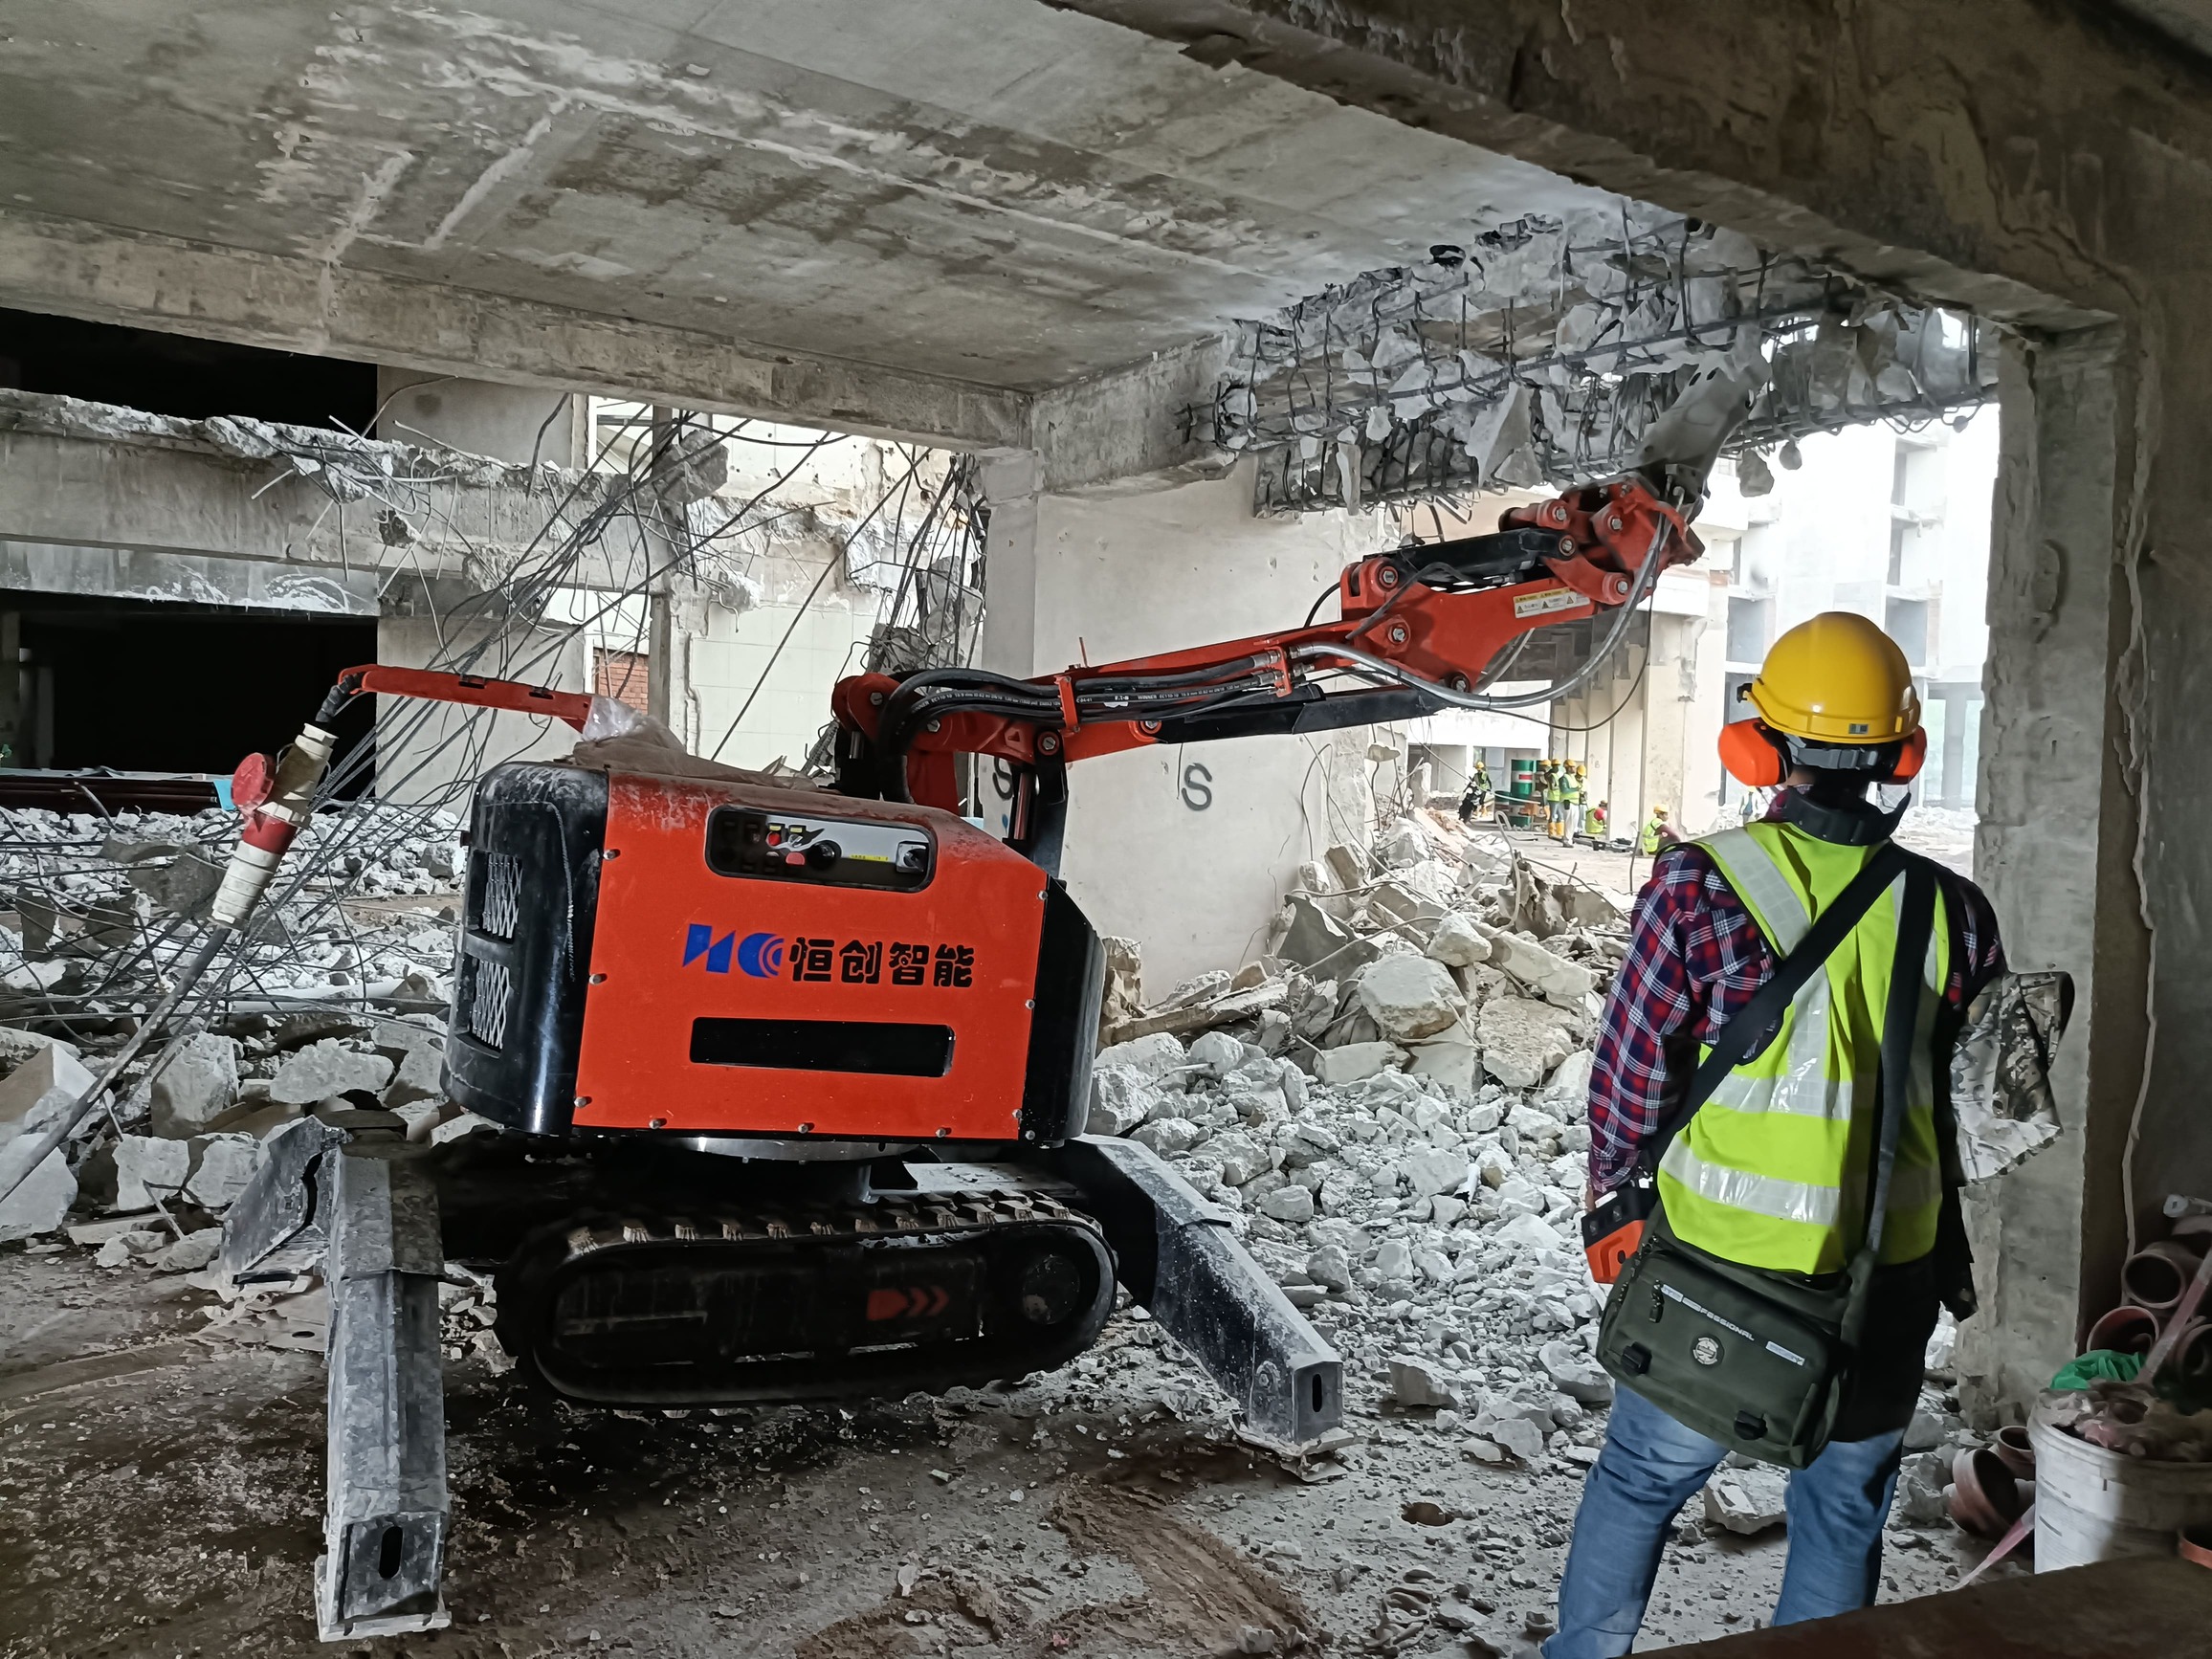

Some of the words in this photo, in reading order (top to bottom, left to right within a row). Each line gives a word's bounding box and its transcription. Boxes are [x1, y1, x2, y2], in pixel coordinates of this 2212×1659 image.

[1182, 763, 1212, 811] S
[788, 937, 974, 987] 恒创智能
